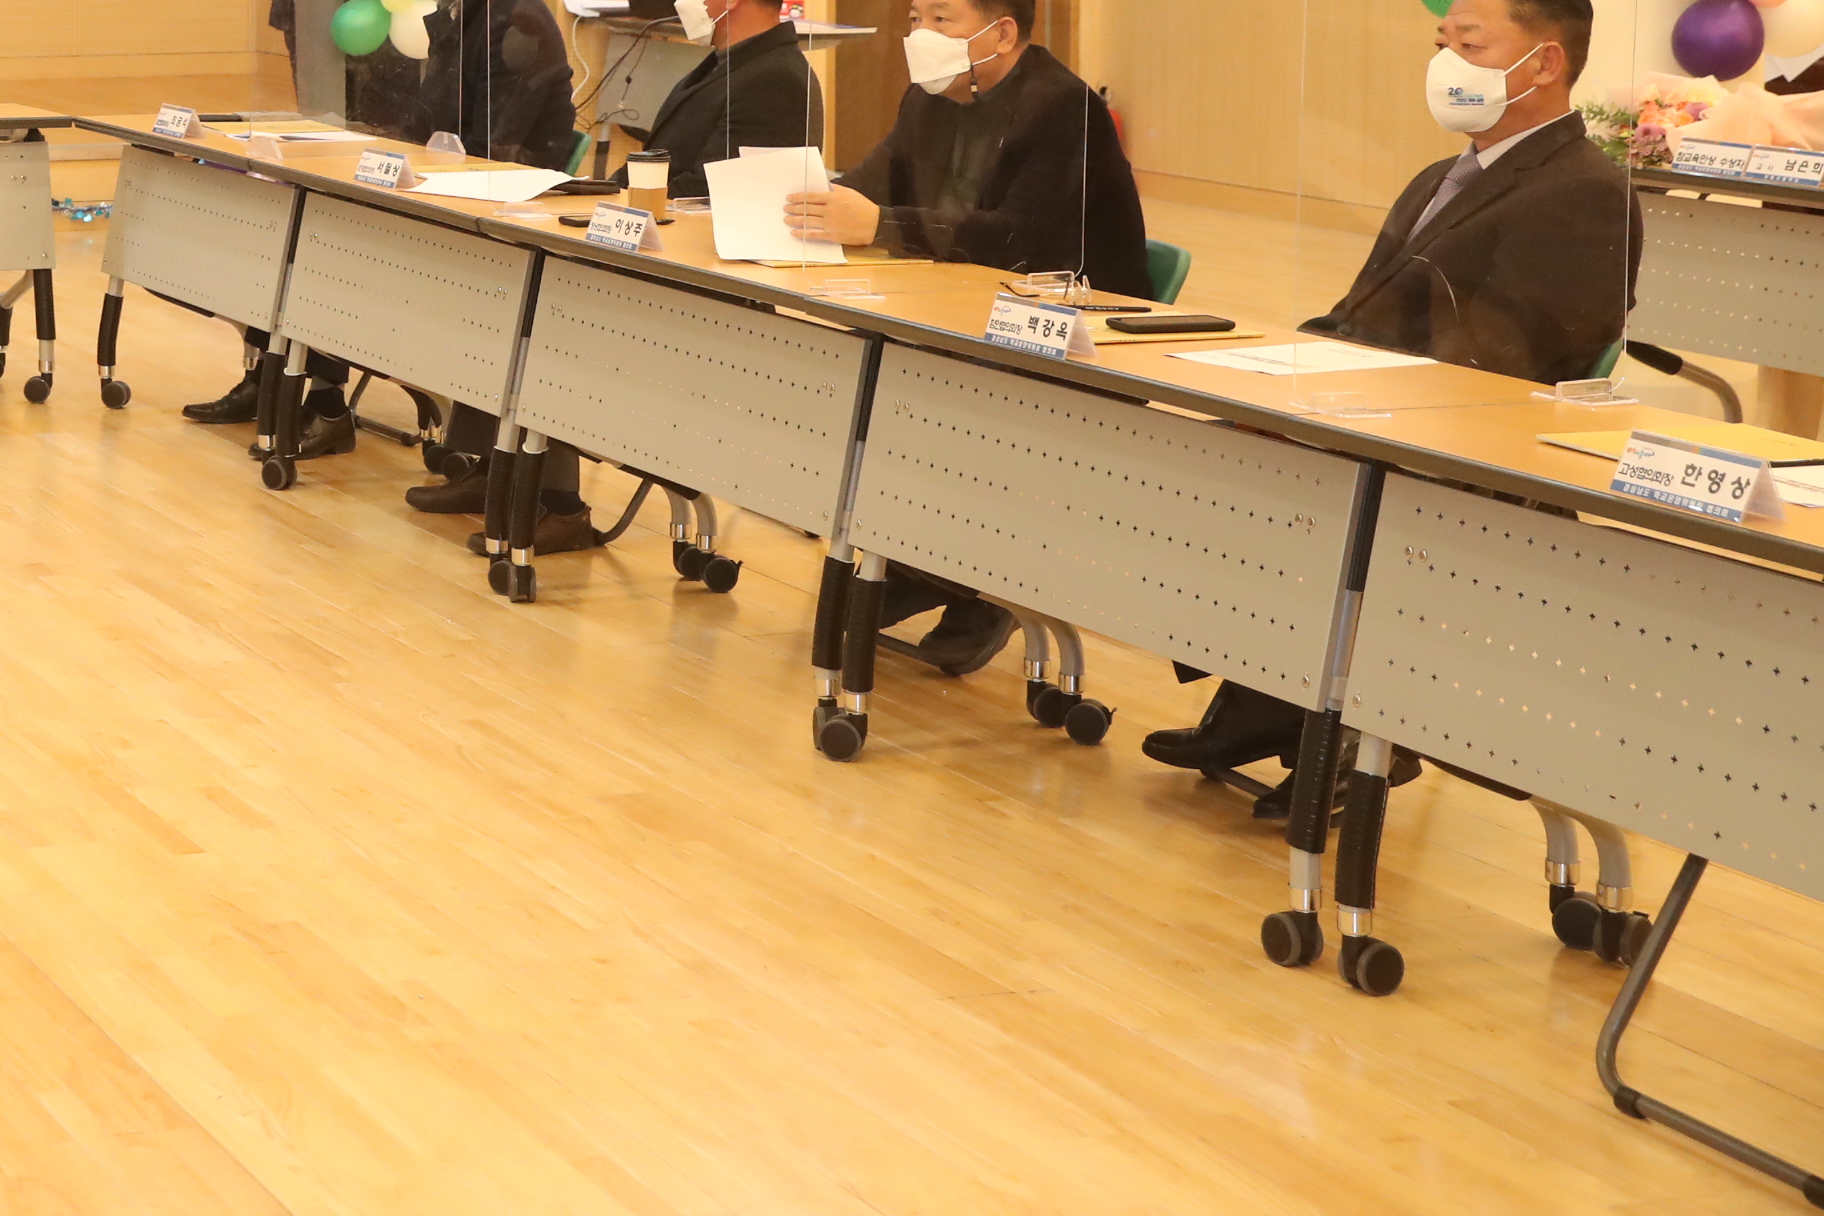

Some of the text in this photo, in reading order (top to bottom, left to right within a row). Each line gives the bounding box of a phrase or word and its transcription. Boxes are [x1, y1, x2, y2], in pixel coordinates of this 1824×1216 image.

[1719, 157, 1745, 169] 수상자
[615, 218, 644, 237] 이상주
[1027, 315, 1068, 341] 백강옥
[1618, 462, 1751, 500] 고성협의회장 한영상
[1622, 484, 1651, 498] 경상남도
